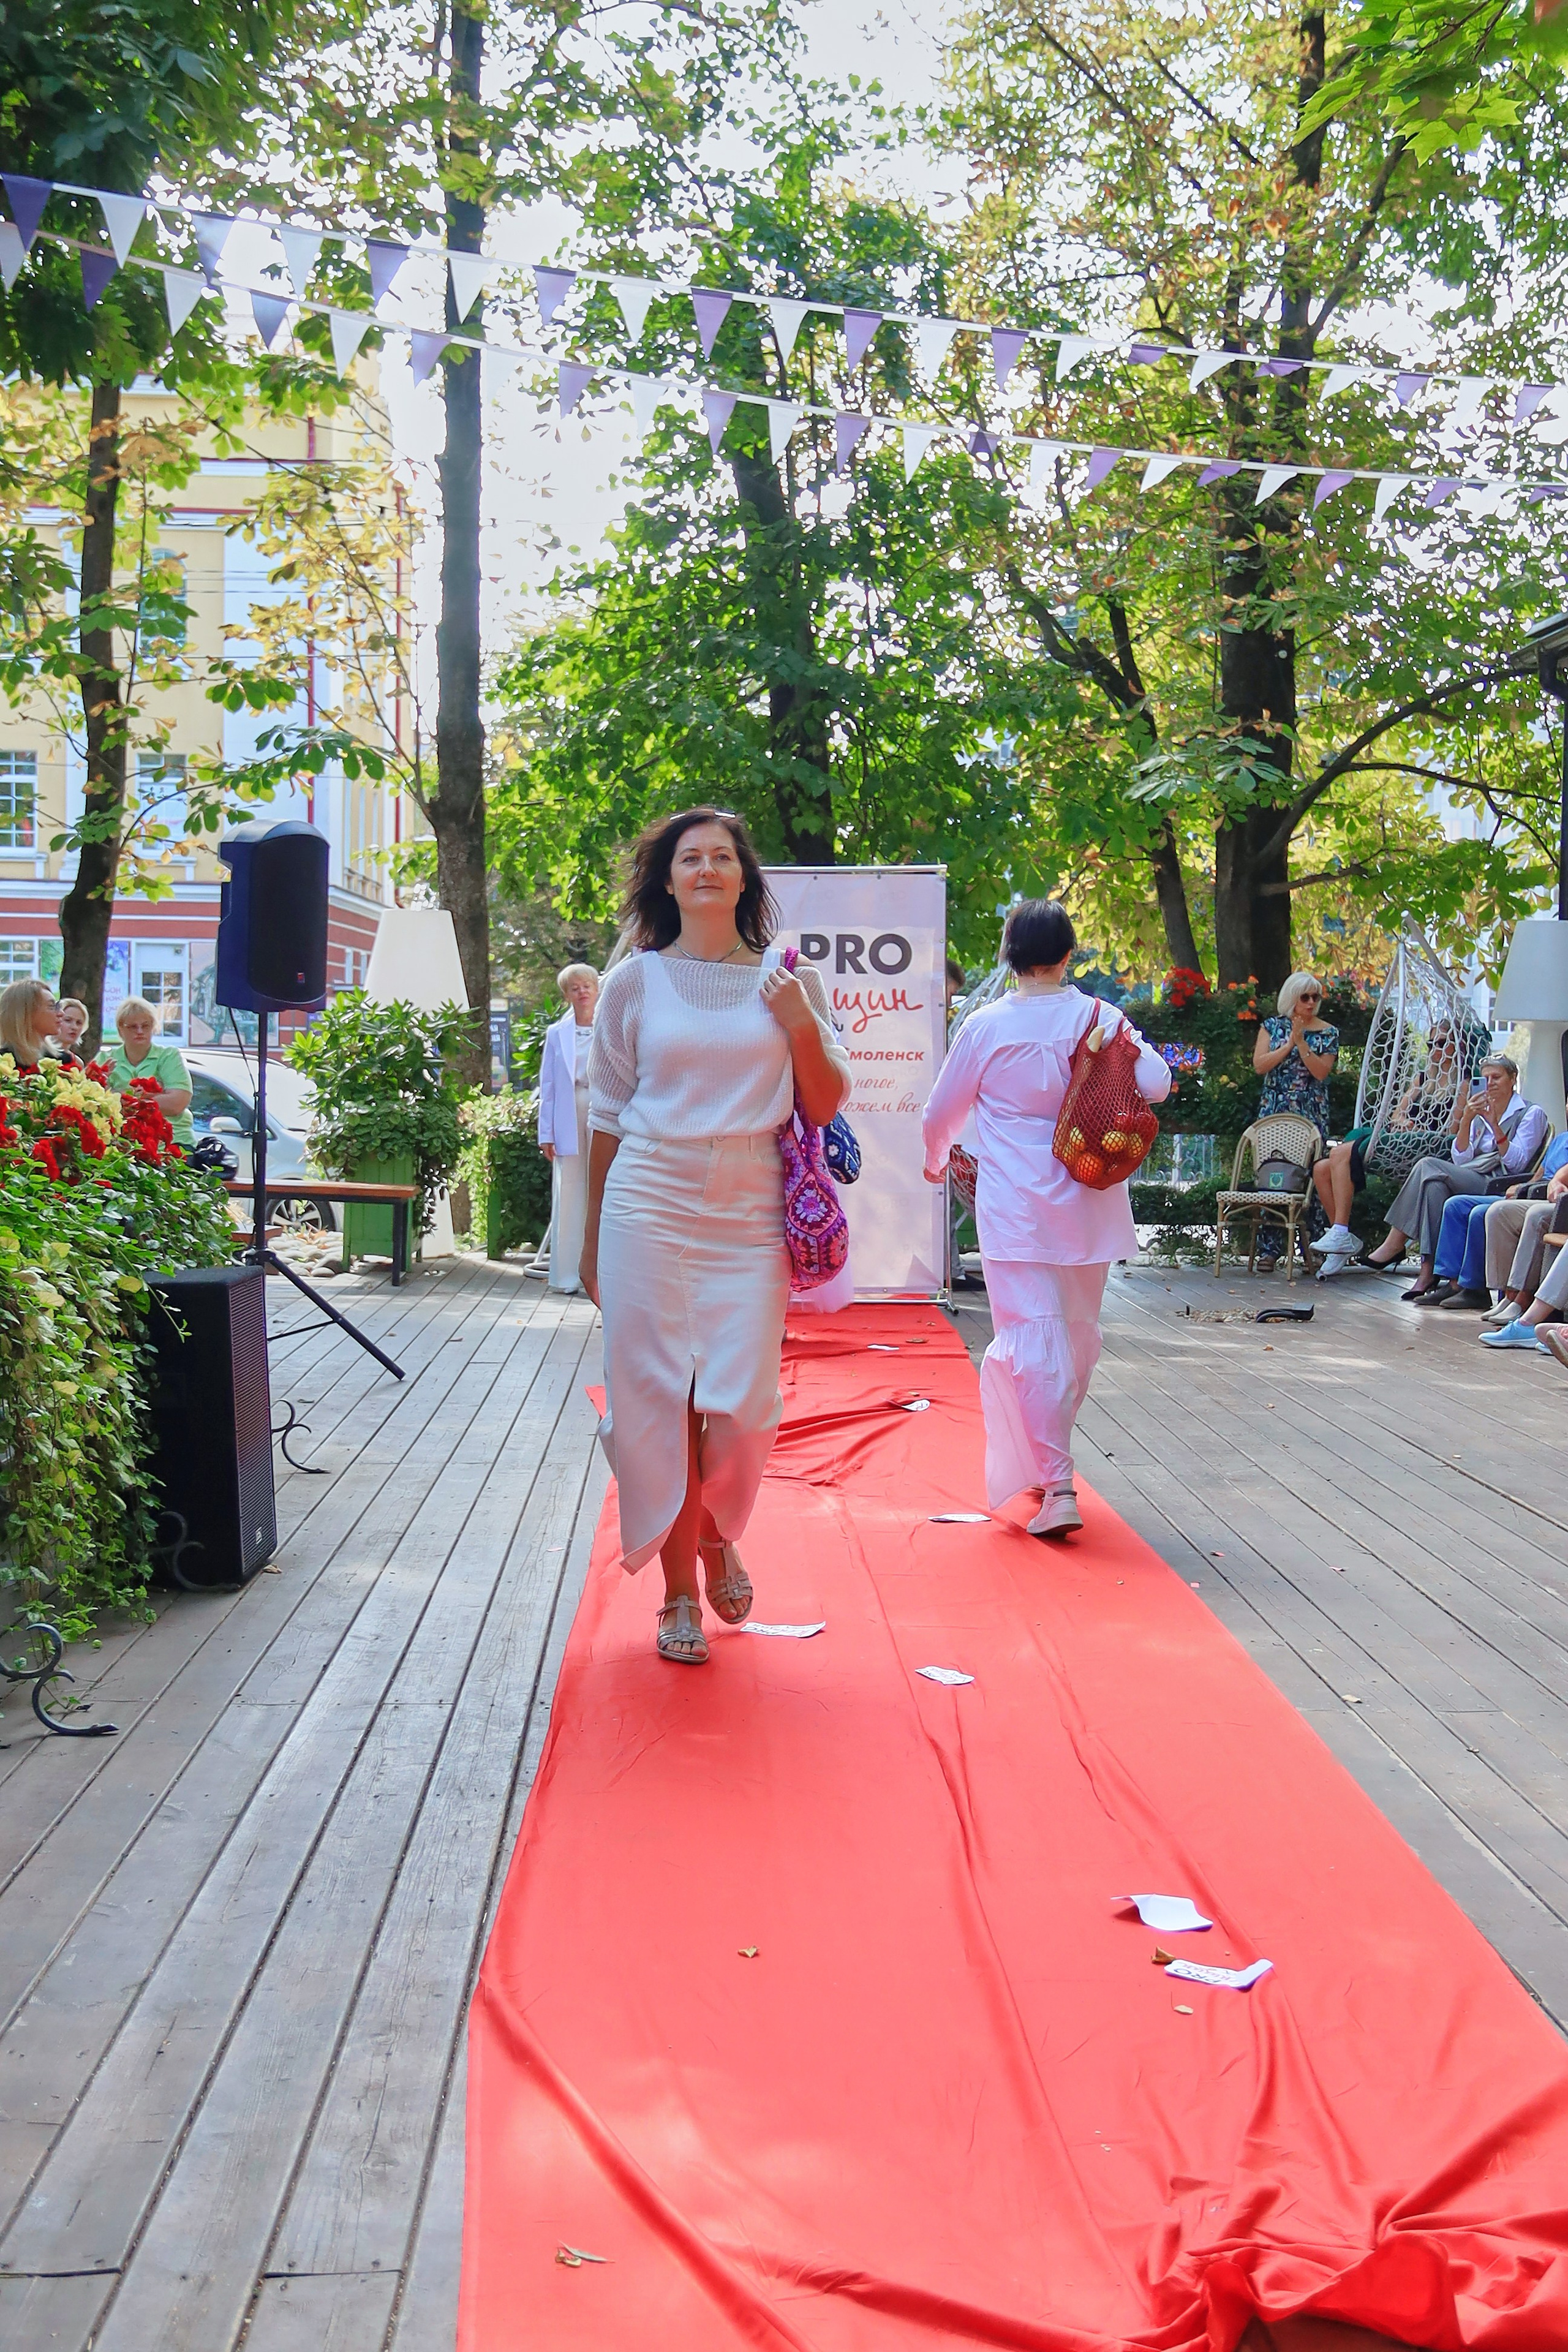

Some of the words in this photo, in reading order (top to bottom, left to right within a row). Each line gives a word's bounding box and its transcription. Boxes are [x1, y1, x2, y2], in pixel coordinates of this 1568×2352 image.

[800, 933, 912, 974] PRO
[834, 987, 924, 1033] щин
[846, 1047, 925, 1061] моленск
[854, 1078, 899, 1090] ногое,
[896, 1092, 921, 1112] все
